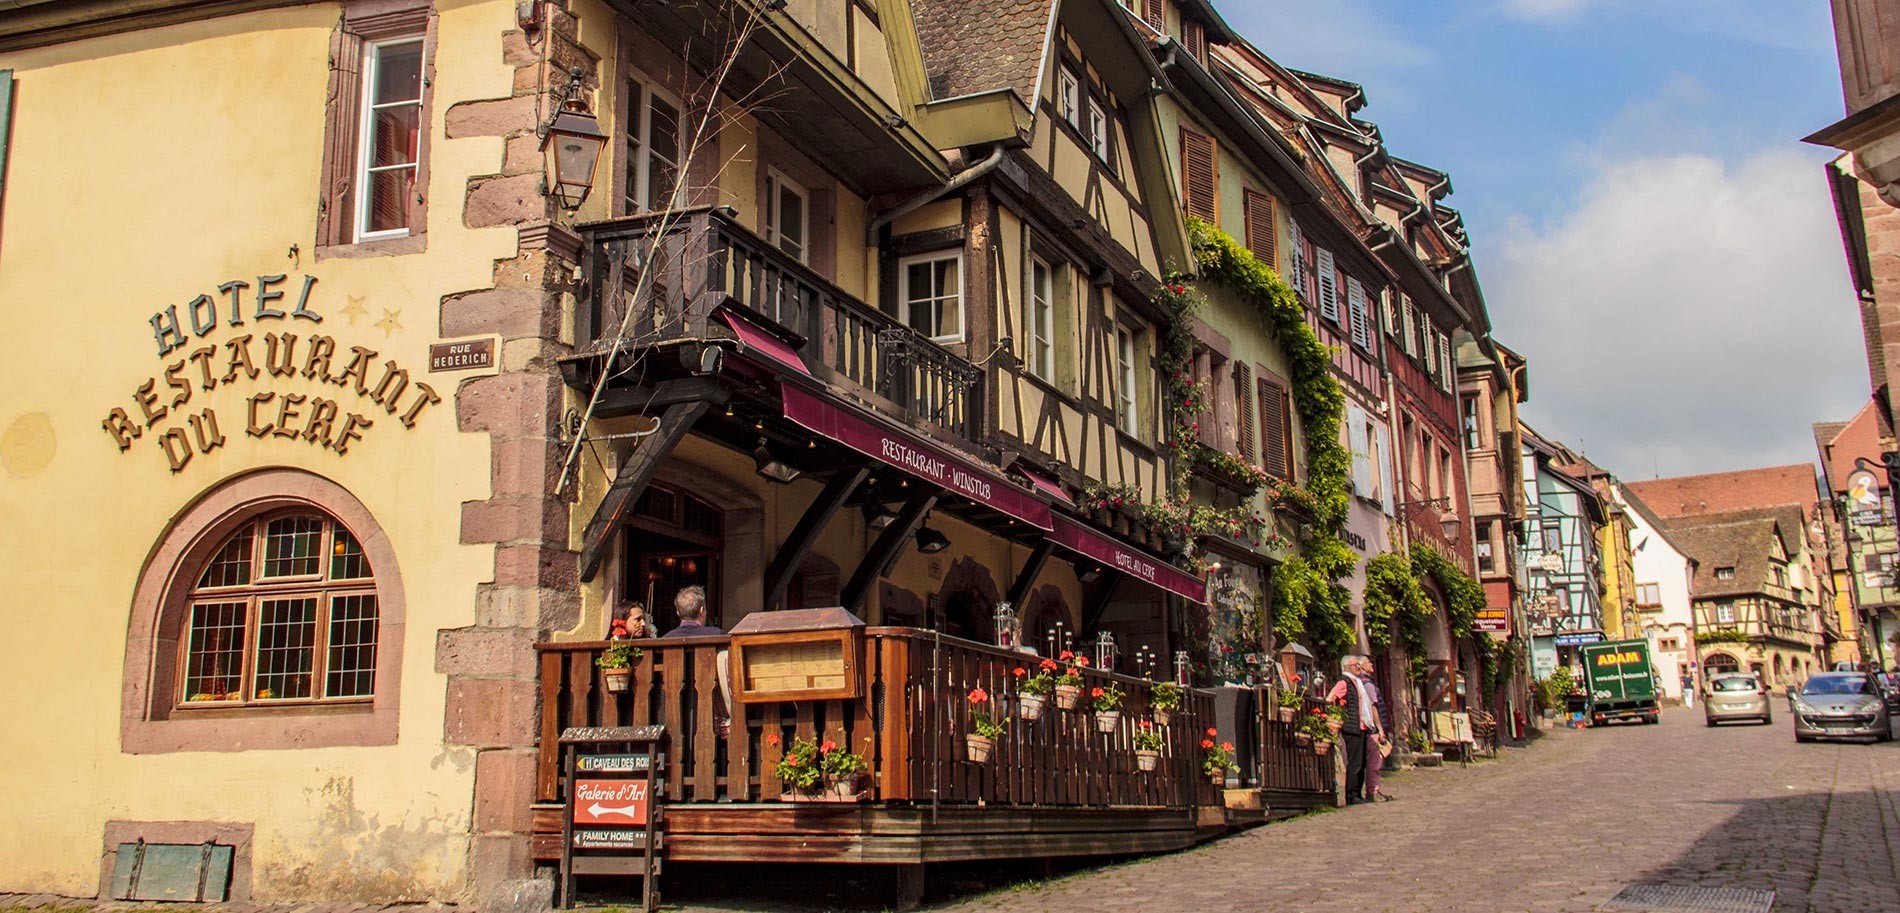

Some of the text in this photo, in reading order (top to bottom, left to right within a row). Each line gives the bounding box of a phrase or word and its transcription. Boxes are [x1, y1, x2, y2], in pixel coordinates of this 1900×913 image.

[149, 274, 323, 358] HOTEL
[450, 344, 471, 354] RUE
[434, 353, 487, 368] HEDERICH
[102, 332, 442, 454] RESTAURANT
[158, 391, 374, 475] DU CERF
[881, 437, 945, 480] RESTAURANT
[953, 468, 991, 500] WINSTUB
[1115, 550, 1133, 570] HOTEL
[1598, 652, 1640, 666] ADAM
[594, 757, 620, 769] CAVEAU
[621, 757, 635, 768] DES
[577, 784, 647, 800] Galerie d'Art
[583, 831, 634, 841] FAMILY HOME
